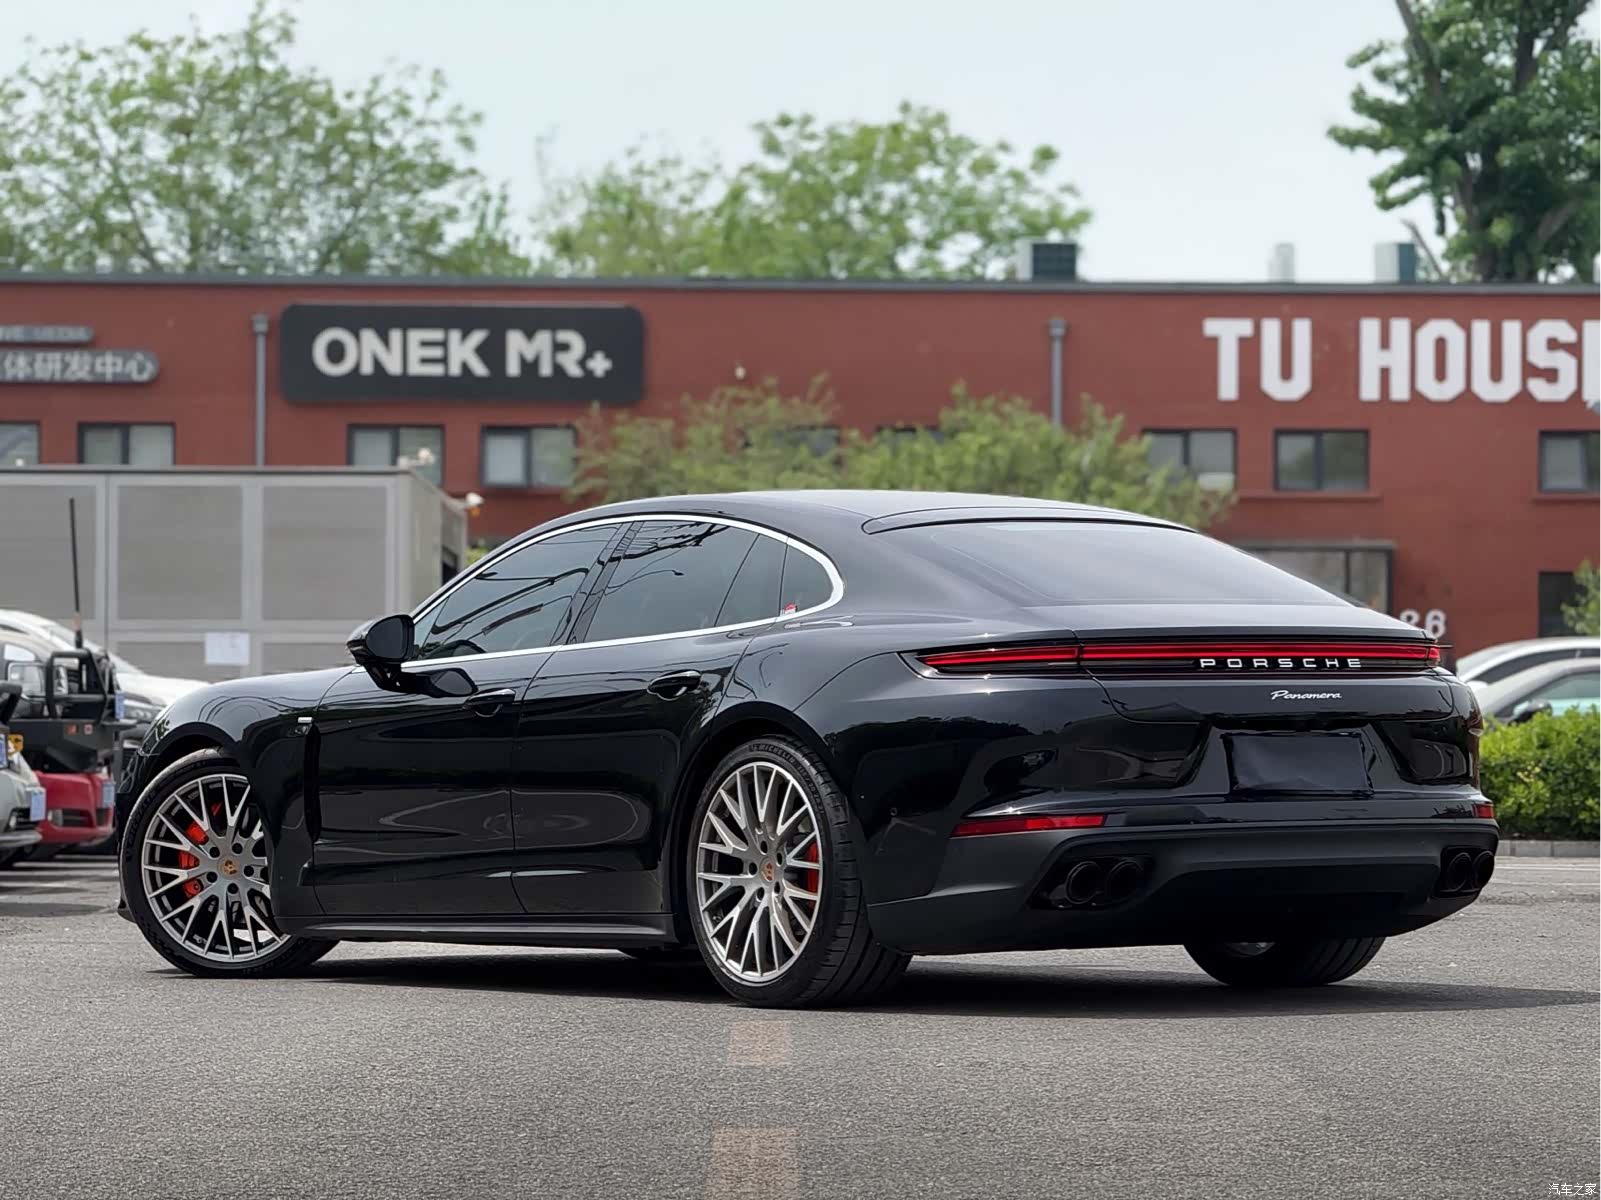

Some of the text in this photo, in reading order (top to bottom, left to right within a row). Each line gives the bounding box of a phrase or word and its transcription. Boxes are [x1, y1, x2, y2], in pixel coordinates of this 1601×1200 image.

[0, 350, 155, 381] 体研发中心
[311, 327, 491, 377] ONEK
[1203, 317, 1312, 402] TU
[1199, 658, 1362, 668] PORSCHE
[1270, 690, 1342, 700] Panamera
